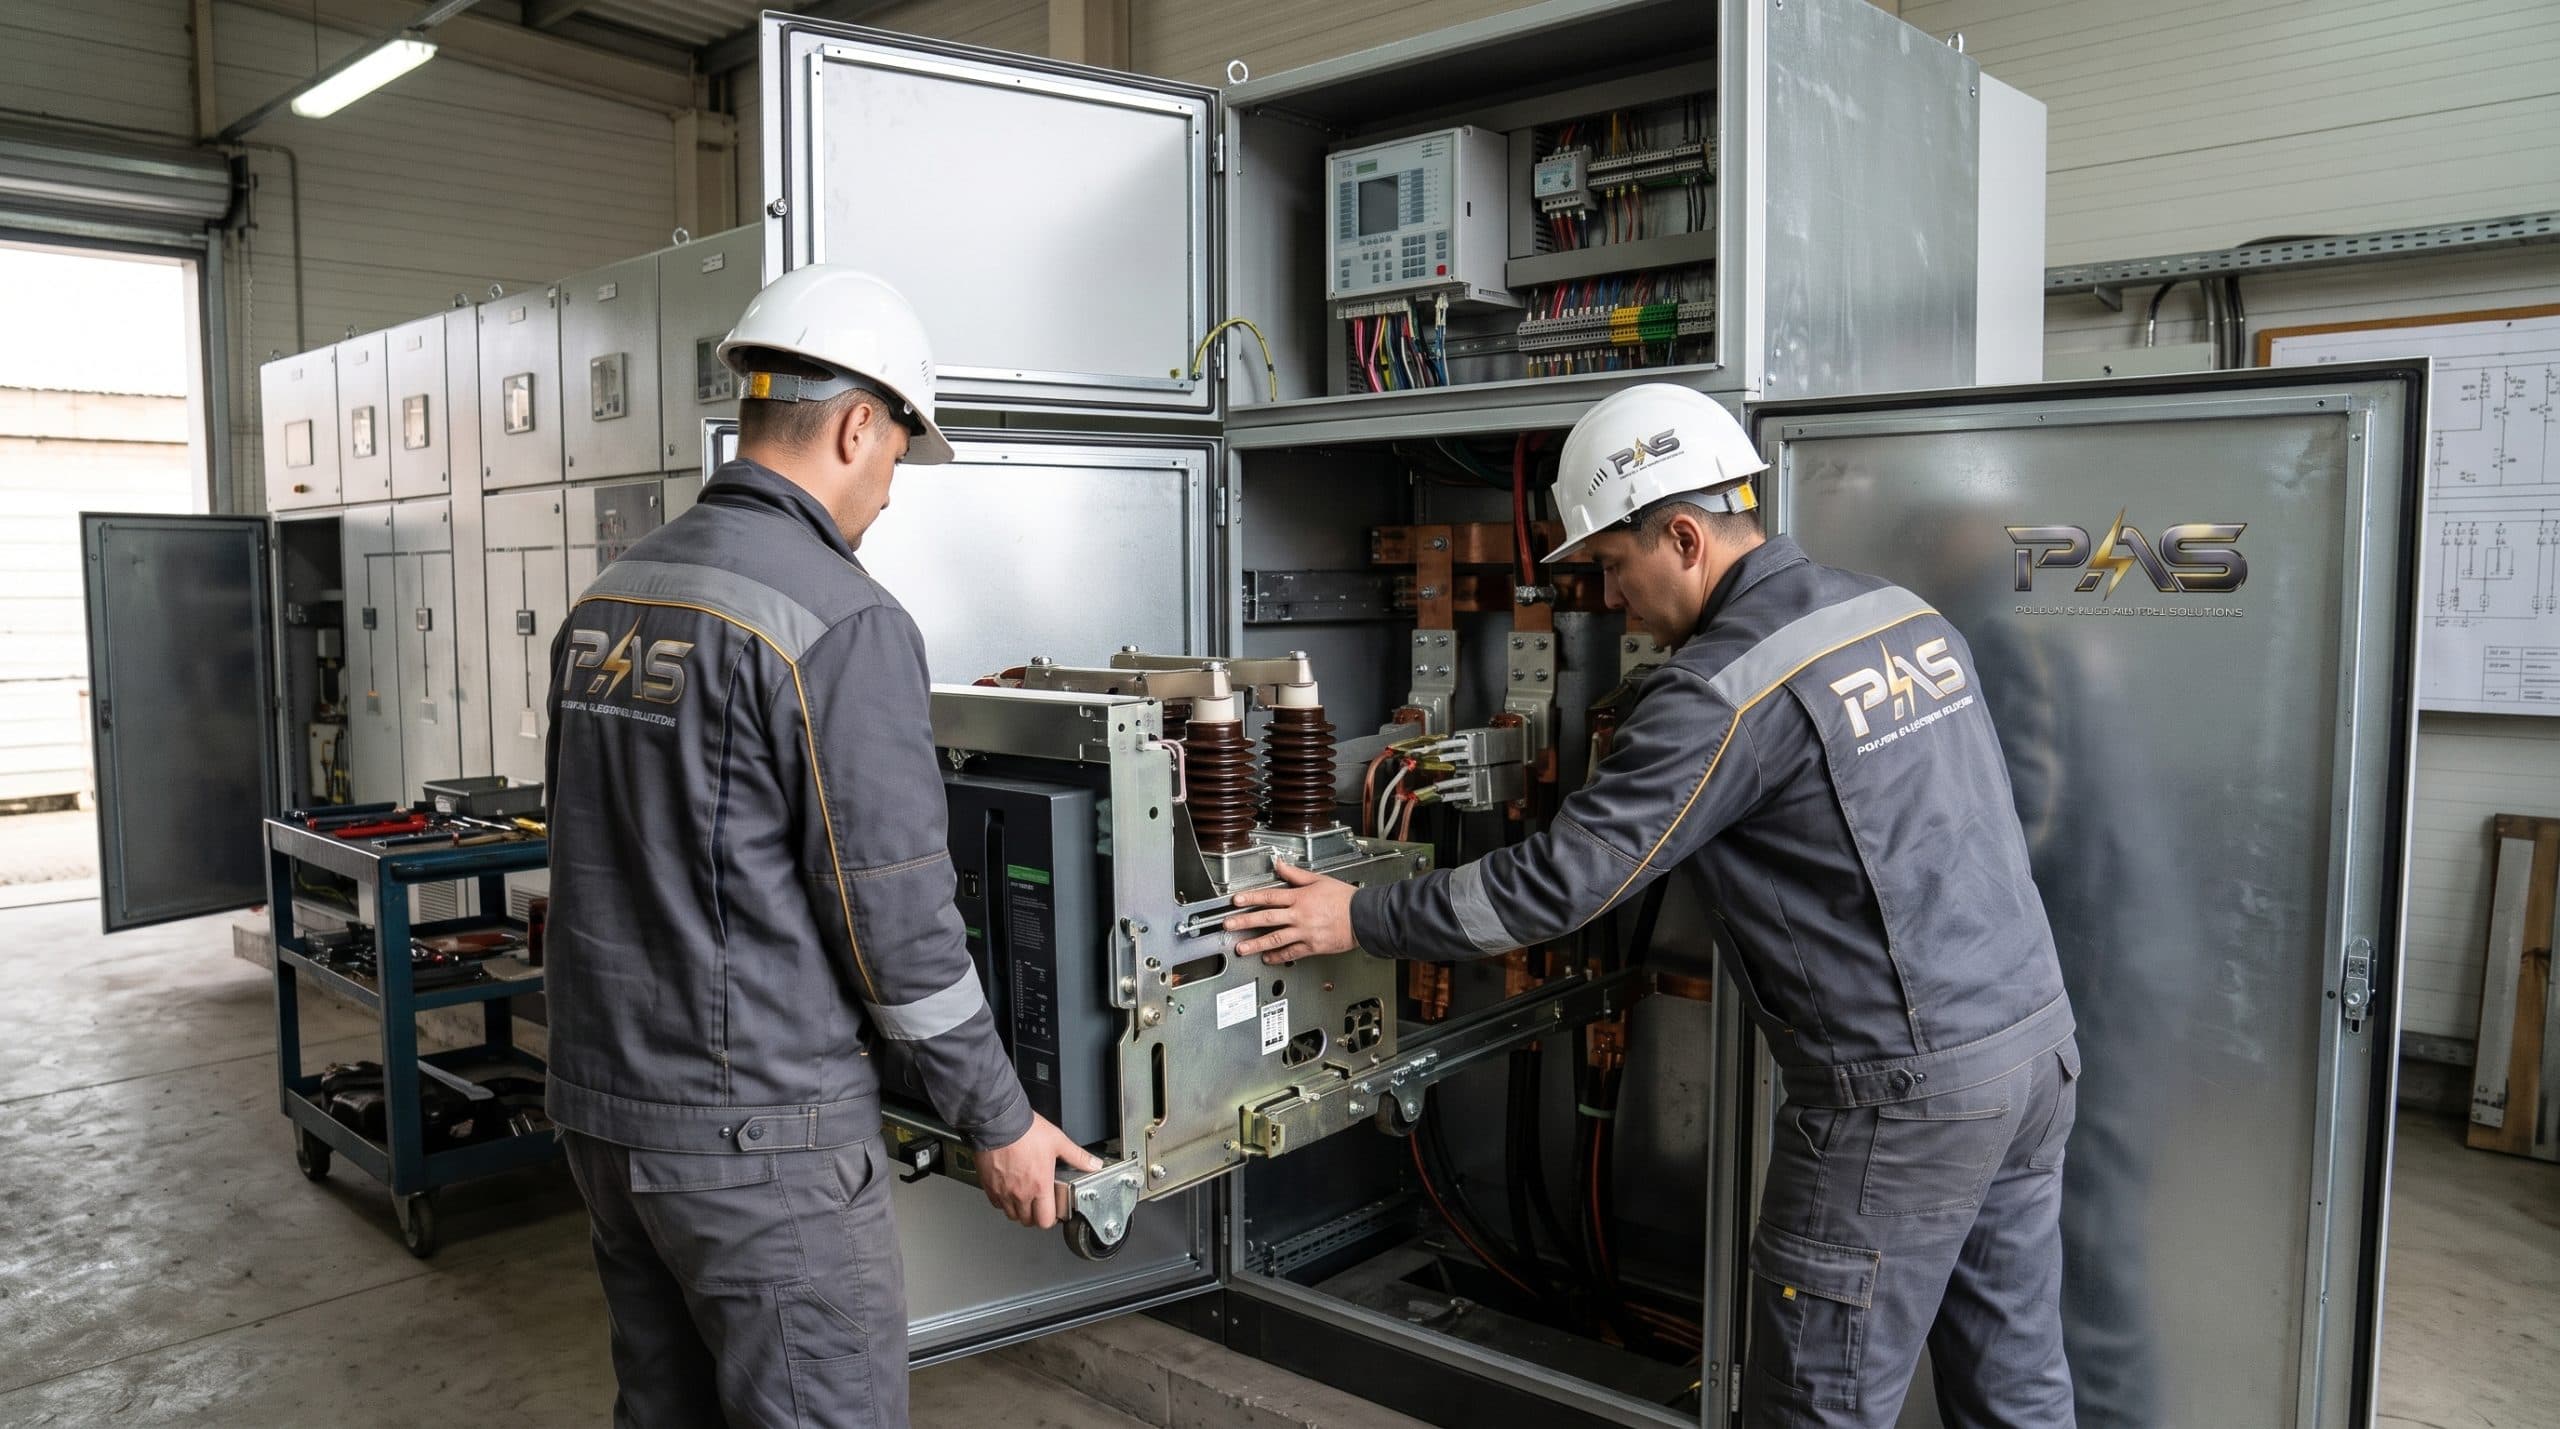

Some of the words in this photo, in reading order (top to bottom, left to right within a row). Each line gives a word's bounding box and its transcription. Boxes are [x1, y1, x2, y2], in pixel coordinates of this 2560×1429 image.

[1606, 428, 1680, 475] PAS
[2003, 504, 2248, 601] PAS
[2168, 607, 2244, 618] SOLUTIONS
[563, 616, 695, 705] PAS
[1829, 637, 1966, 739] PAS
